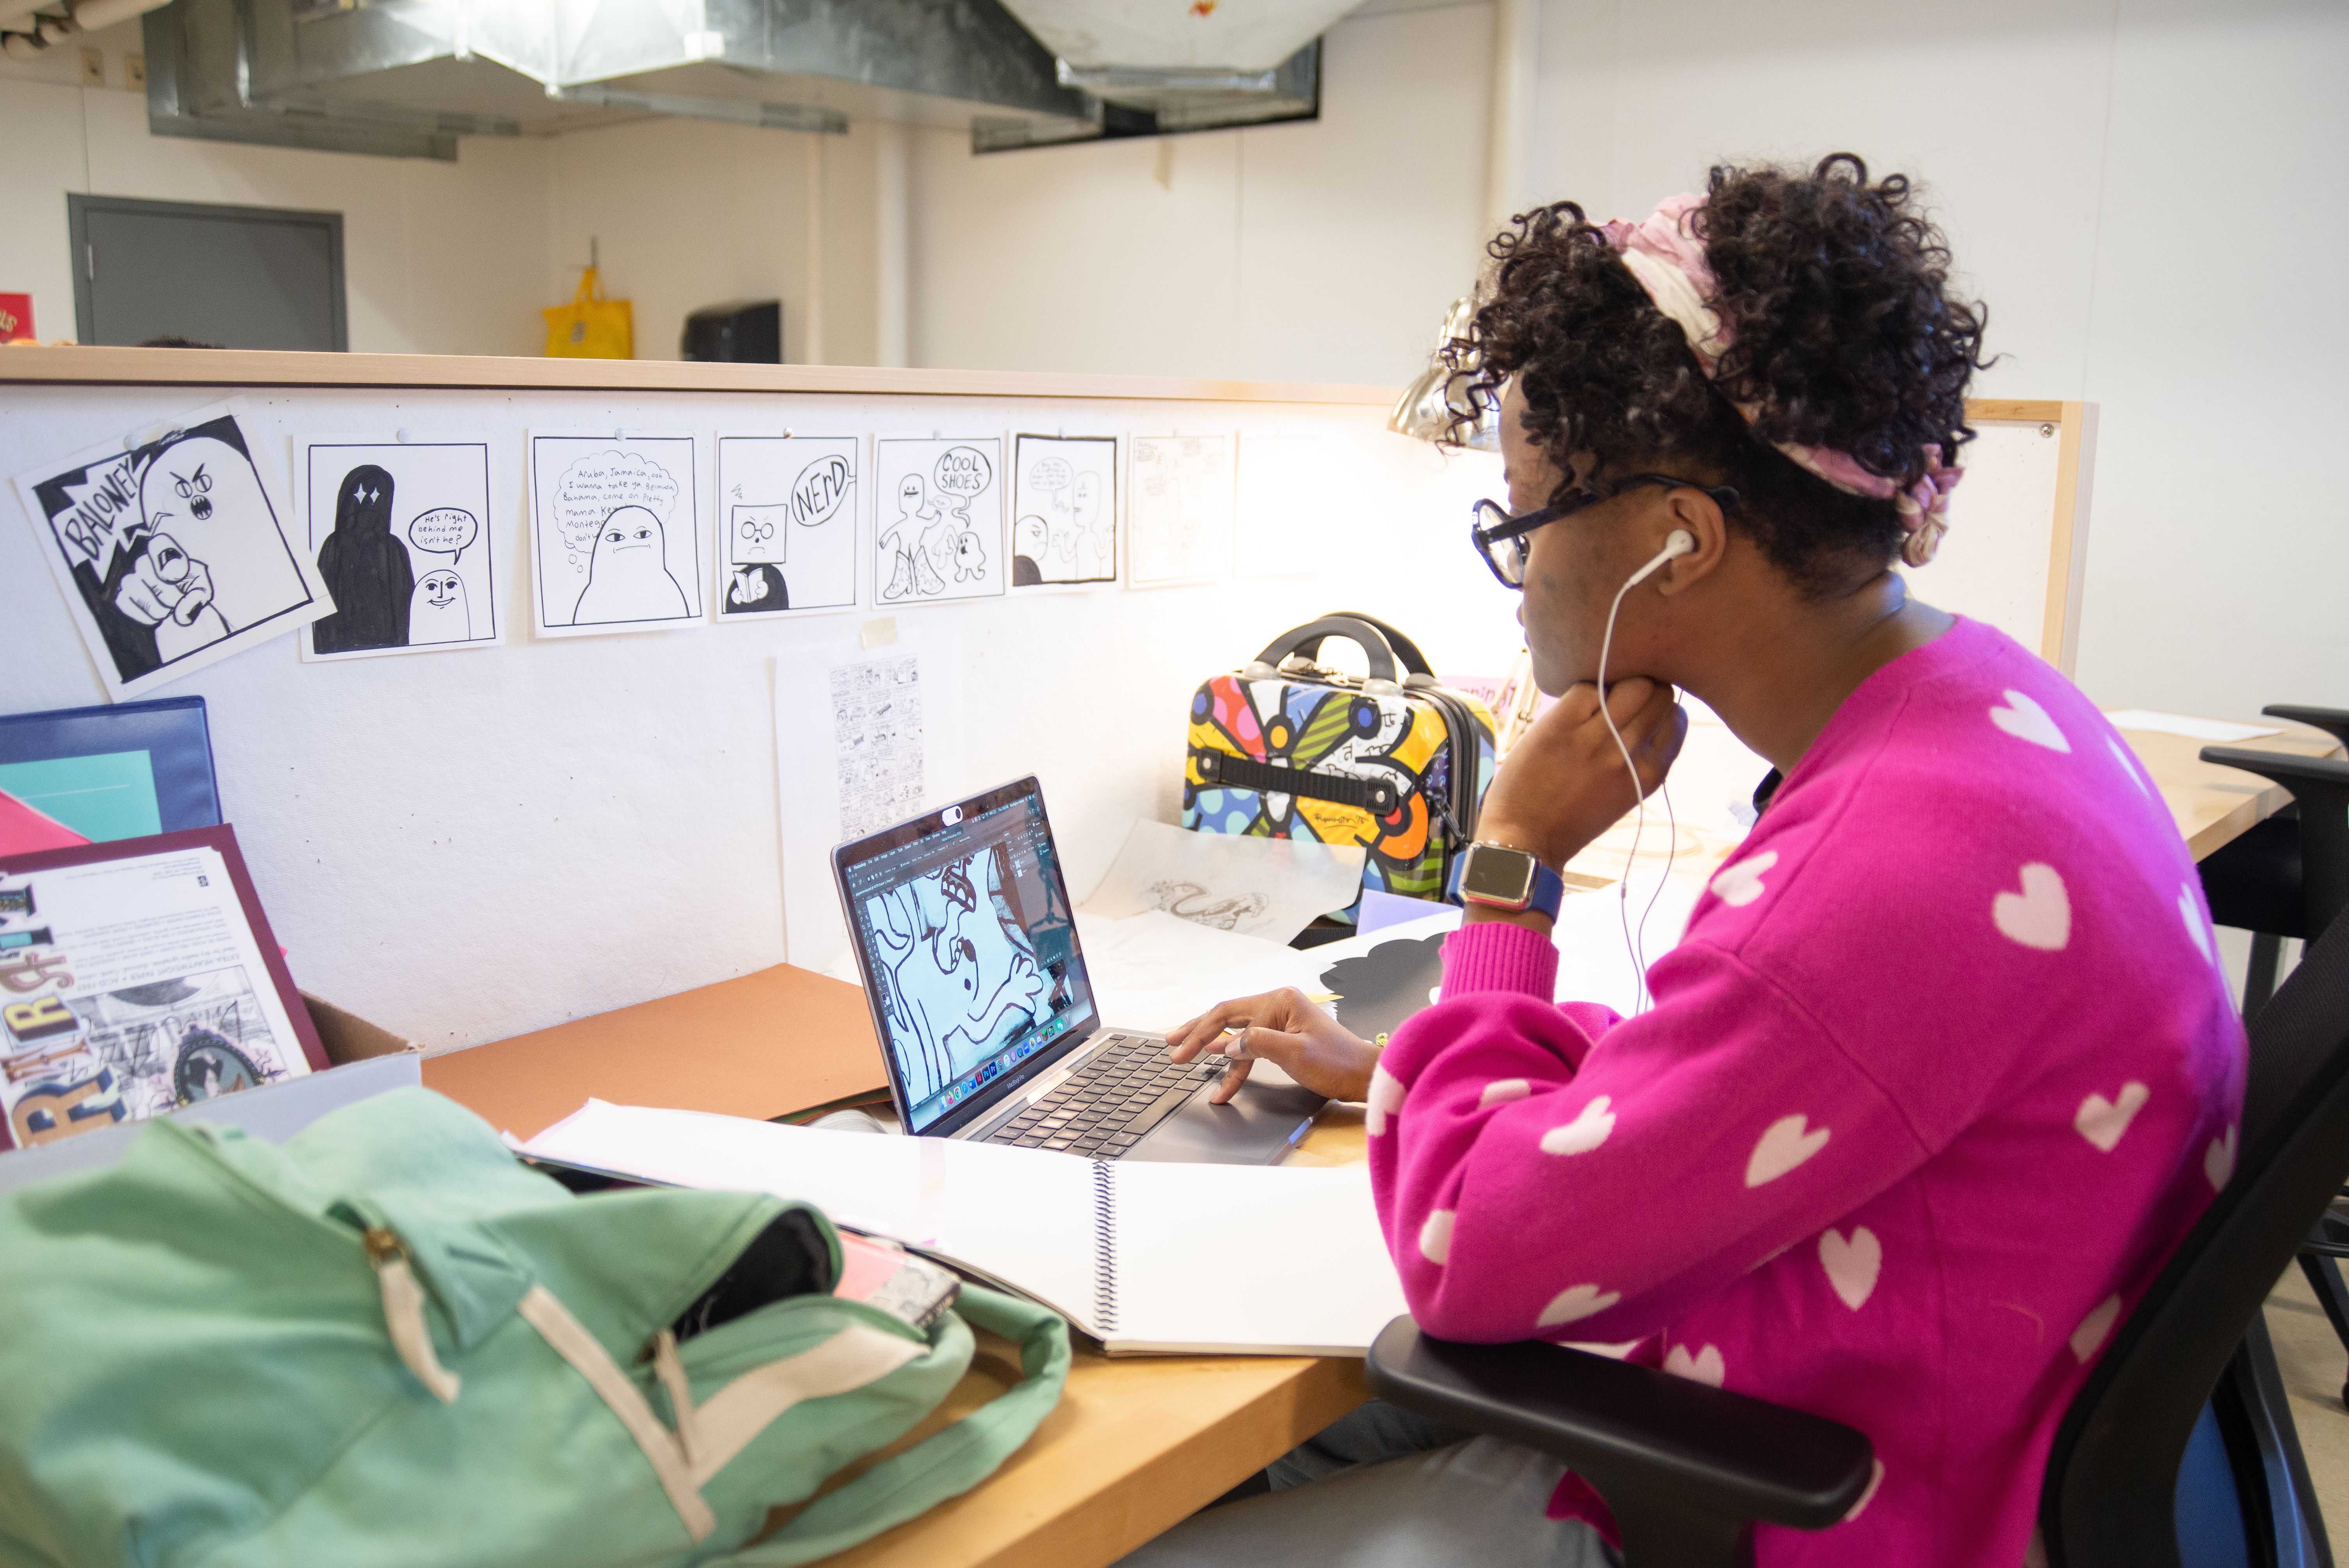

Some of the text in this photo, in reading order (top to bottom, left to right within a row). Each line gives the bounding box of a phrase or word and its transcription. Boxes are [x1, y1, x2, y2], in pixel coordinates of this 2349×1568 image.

[943, 453, 978, 472] COOL
[578, 469, 608, 479] Aruba,
[610, 468, 650, 480] Jamaica,
[608, 480, 627, 489] take
[942, 473, 982, 489] SHOES
[563, 492, 600, 502] Bahama,
[65, 458, 138, 561] BALONEY
[425, 513, 467, 524] He's right
[576, 533, 590, 541] don't
[1007, 1077, 1020, 1089] MacBook
